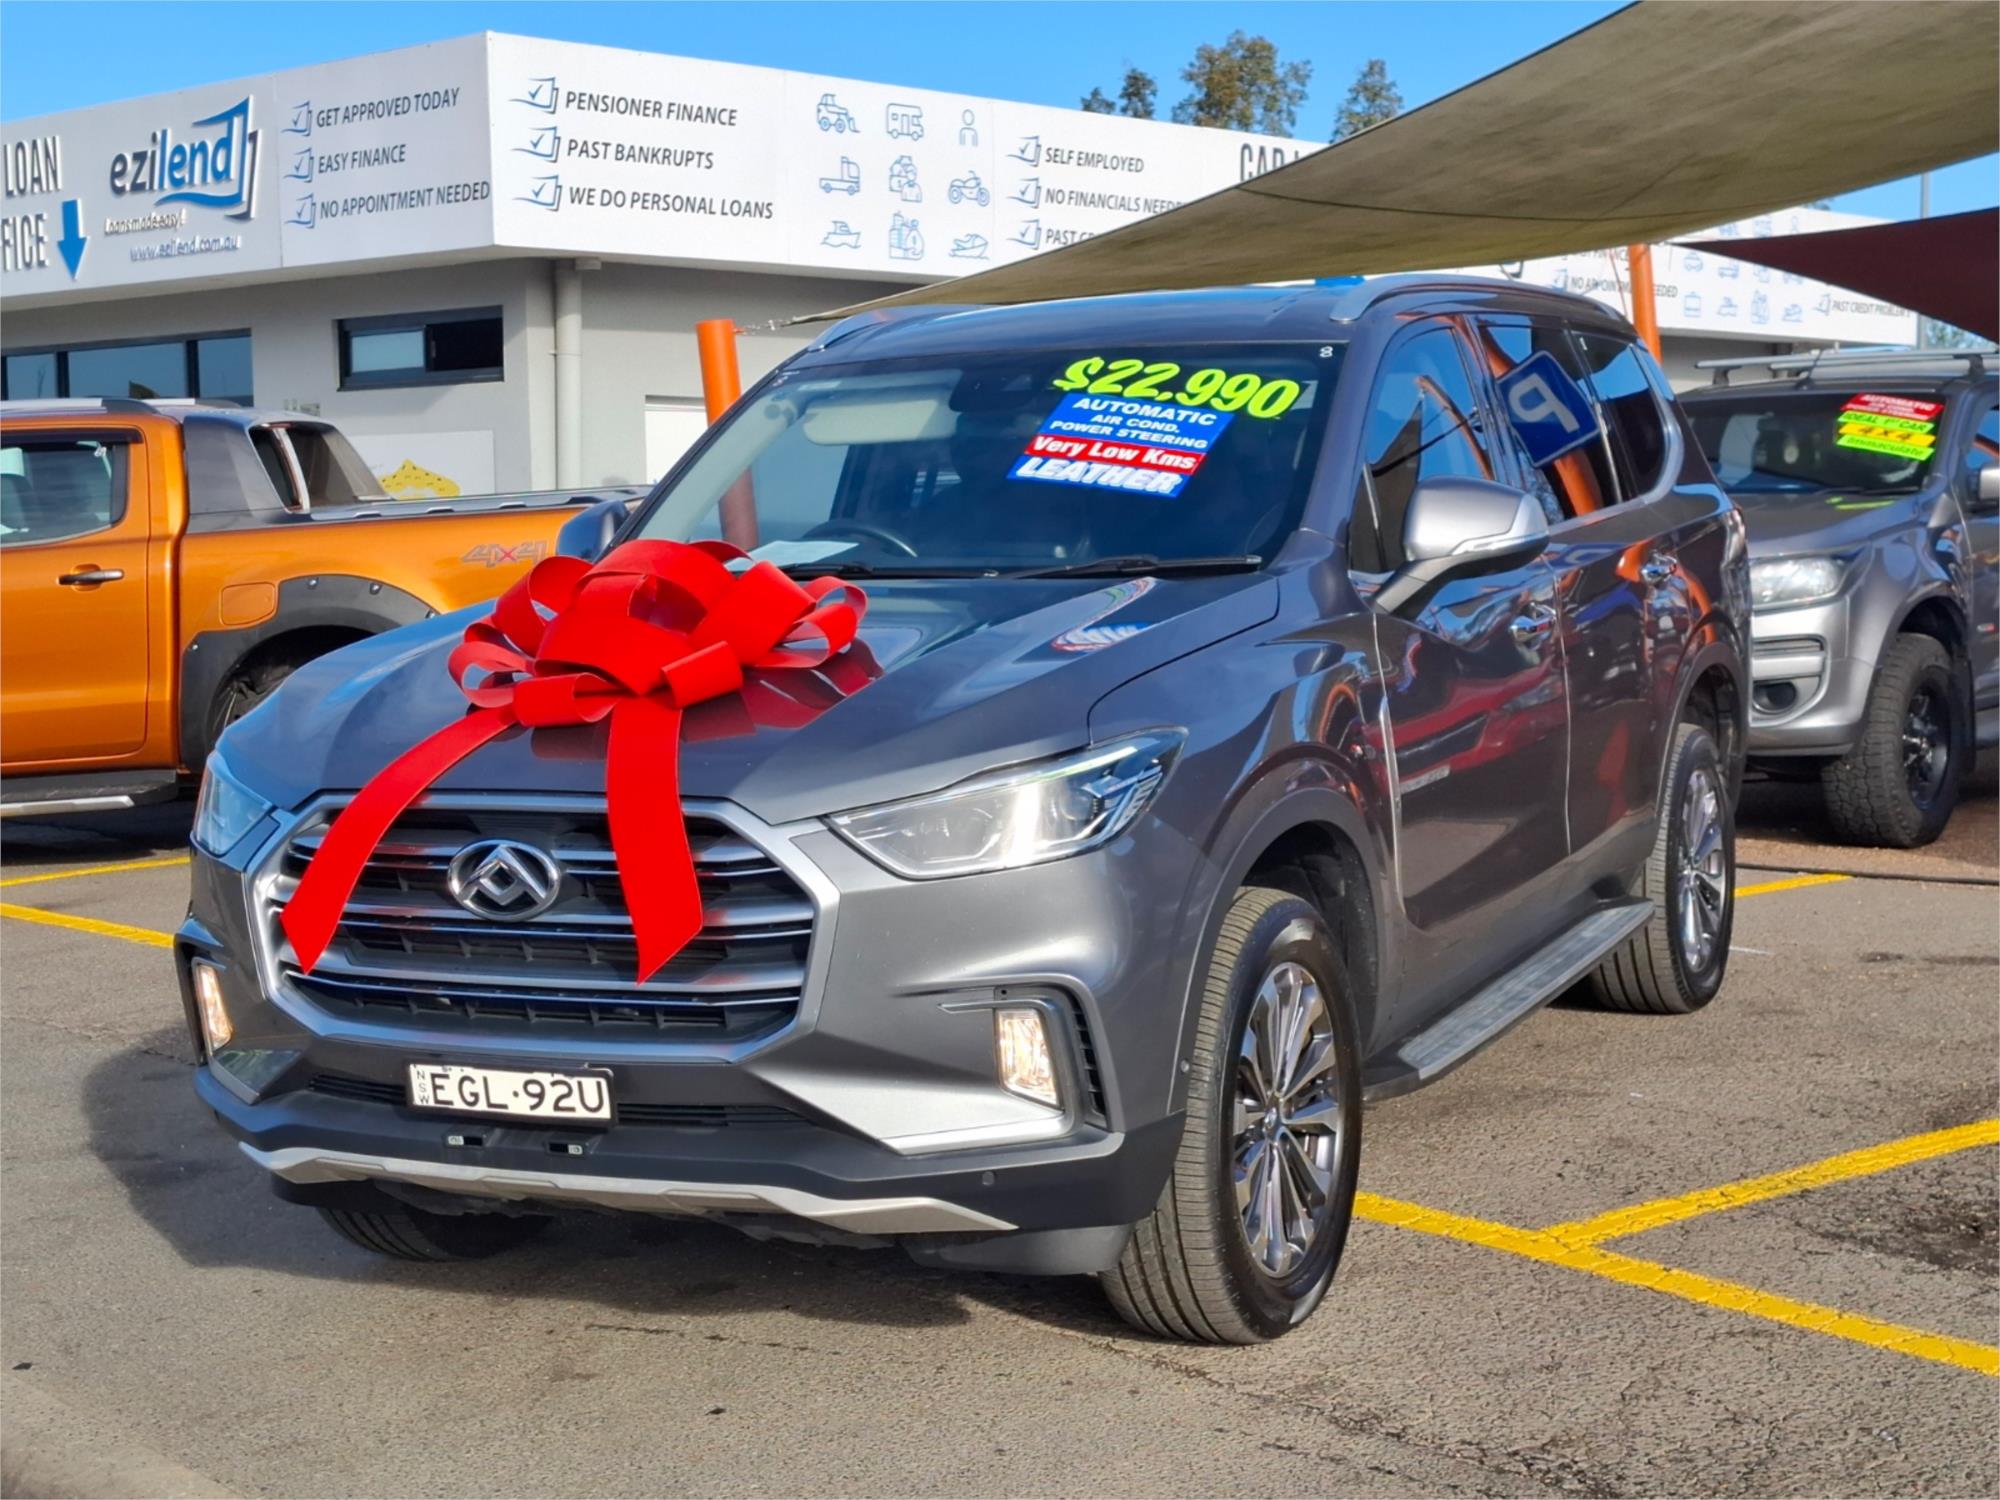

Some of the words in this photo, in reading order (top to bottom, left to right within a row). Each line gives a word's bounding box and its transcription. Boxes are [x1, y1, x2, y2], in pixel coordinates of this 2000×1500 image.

[317, 108, 340, 128] GET
[342, 96, 411, 124] APPROVED
[414, 87, 460, 112] TODAY
[566, 91, 663, 118] PENSIONER
[666, 102, 737, 126] FINANCE
[4, 134, 62, 197] LOAN
[110, 119, 236, 195] ezilend
[318, 152, 348, 174] EASY
[351, 144, 406, 169] FINANCE
[567, 138, 611, 160] PAST
[615, 143, 714, 169] BANKRUPTS
[1045, 147, 1075, 165] SELF
[1076, 151, 1144, 173] EMPLOYED
[320, 201, 339, 219] NO
[341, 188, 433, 217] APPOINTMENT
[436, 181, 490, 205] NEEDED
[569, 186, 596, 206] WE
[600, 189, 626, 208] DO
[630, 191, 716, 215] PERSONAL
[721, 199, 773, 219] LOANS
[1045, 188, 1065, 204] NO
[1067, 190, 1140, 212] FINANCIALS
[1045, 229, 1077, 245] PAST
[1053, 356, 1300, 418] $22,990
[1072, 398, 1217, 426] AUTOMATIC
[1090, 414, 1123, 426] AIR
[1126, 418, 1181, 433] COND.
[1049, 420, 1113, 436] POWER
[1116, 428, 1208, 449] STEERING
[1033, 436, 1087, 457] Very
[1088, 442, 1140, 462] Low
[1141, 449, 1197, 469] Kms
[1015, 456, 1184, 494] LEATHER
